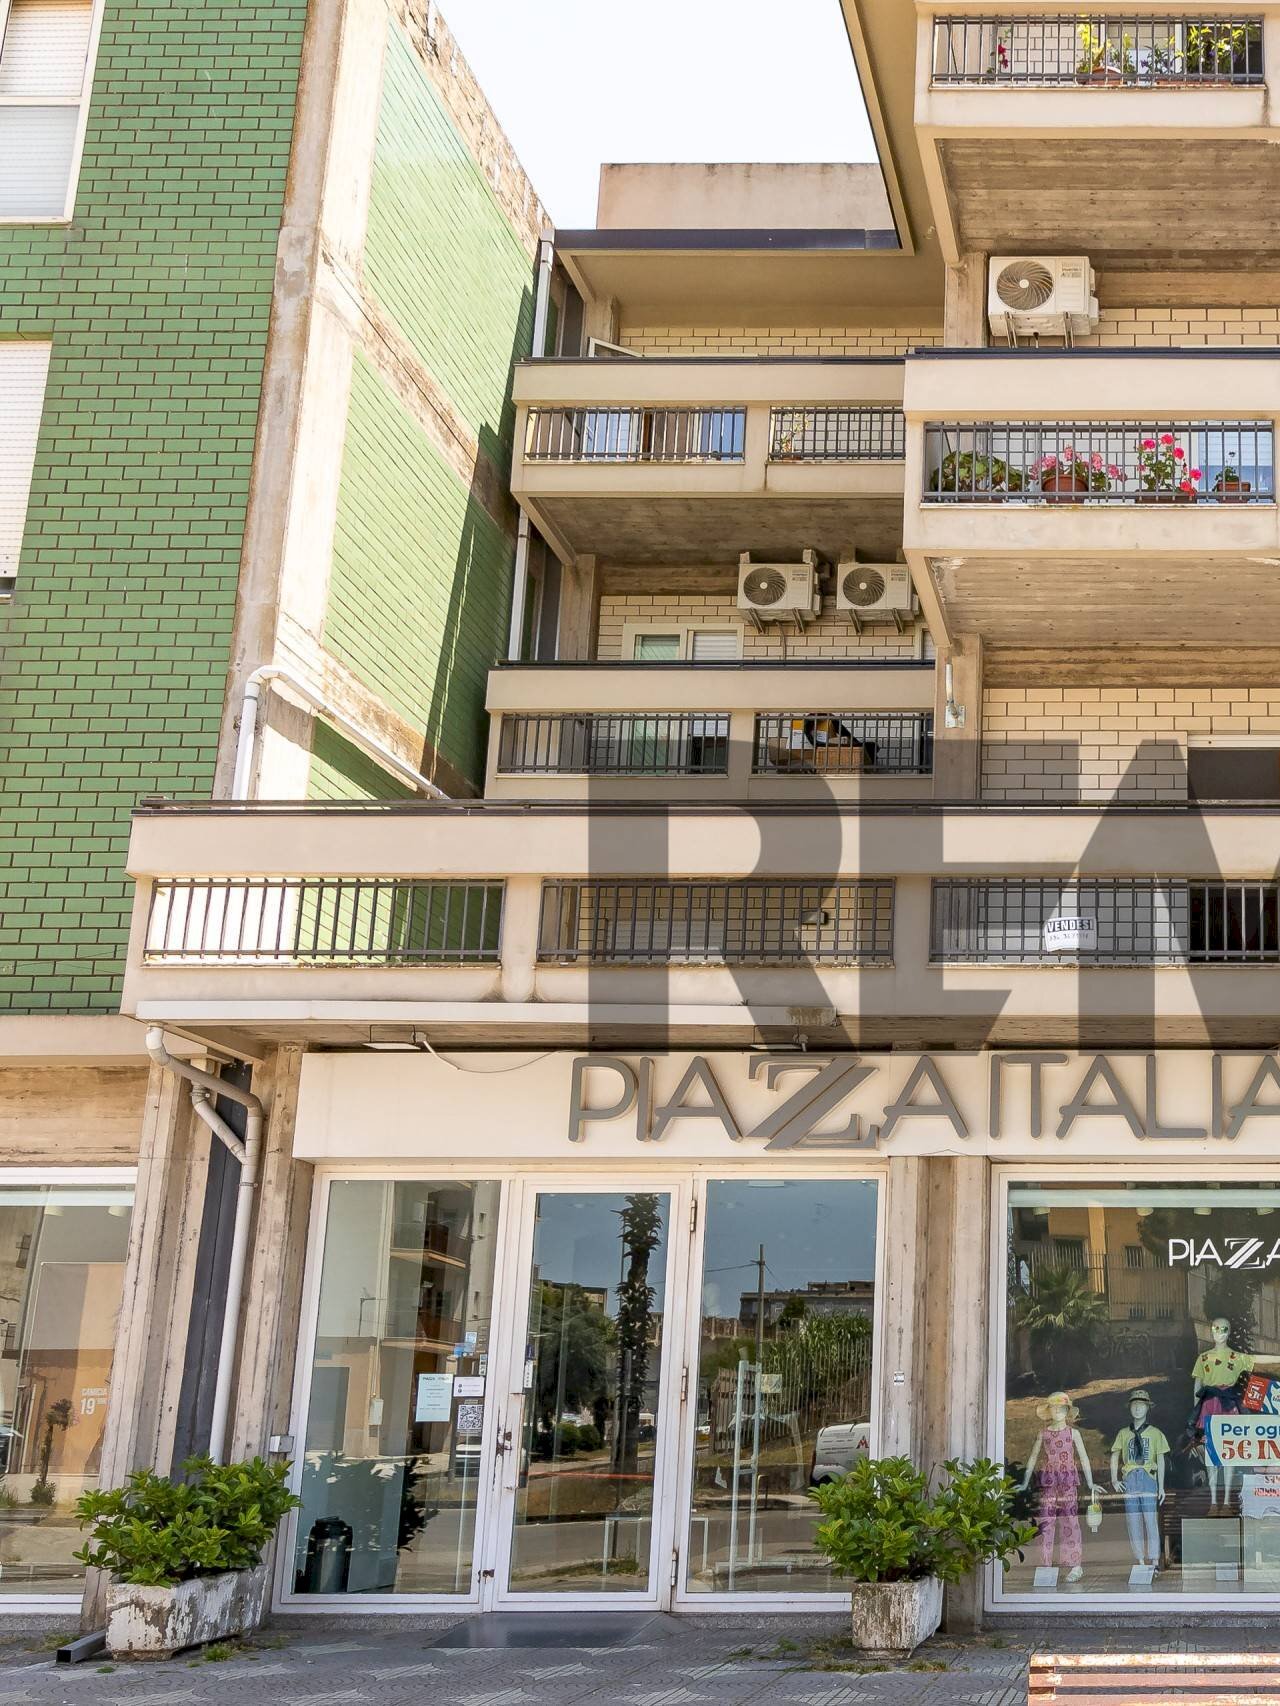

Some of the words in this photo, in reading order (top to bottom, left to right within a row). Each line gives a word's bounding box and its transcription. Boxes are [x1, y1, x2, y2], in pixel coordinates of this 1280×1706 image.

[1047, 919, 1094, 933] VENDESI
[567, 1055, 971, 1151] PIAZZA
[1221, 1423, 1250, 1436] Per
[1221, 1439, 1252, 1460] 5€
